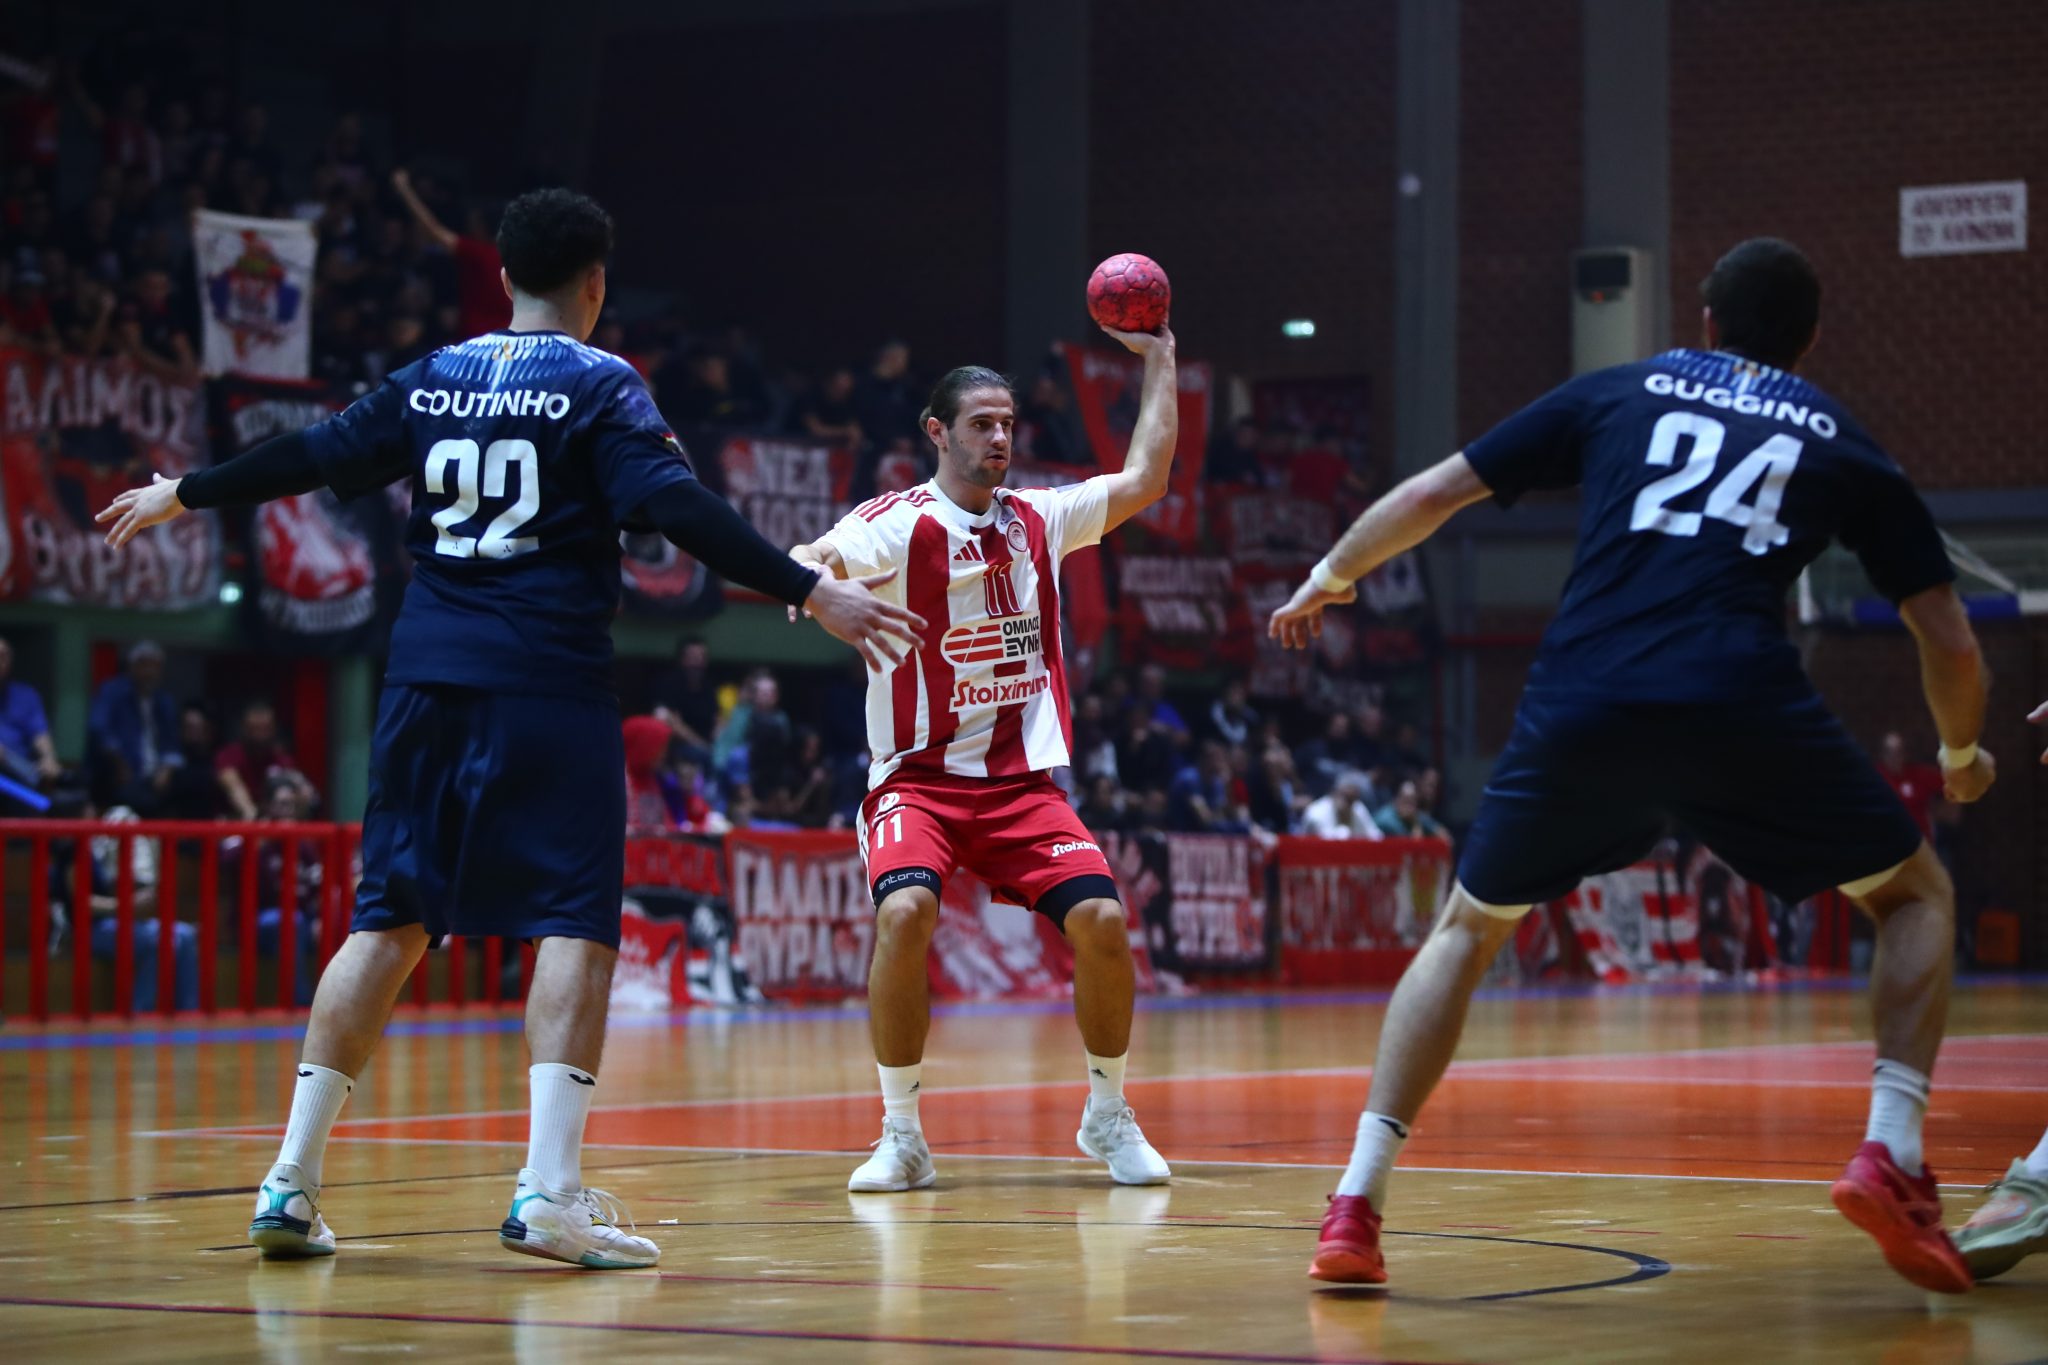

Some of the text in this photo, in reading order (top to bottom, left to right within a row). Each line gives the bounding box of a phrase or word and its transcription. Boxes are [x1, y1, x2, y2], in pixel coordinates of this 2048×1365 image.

[409, 388, 571, 420] COUTINHO
[1644, 373, 1838, 439] GUGGINO
[424, 438, 541, 559] 22
[1629, 411, 1804, 556] 24
[983, 561, 1024, 619] 11
[875, 813, 902, 849] 11
[1051, 840, 1102, 857] Stoixim
